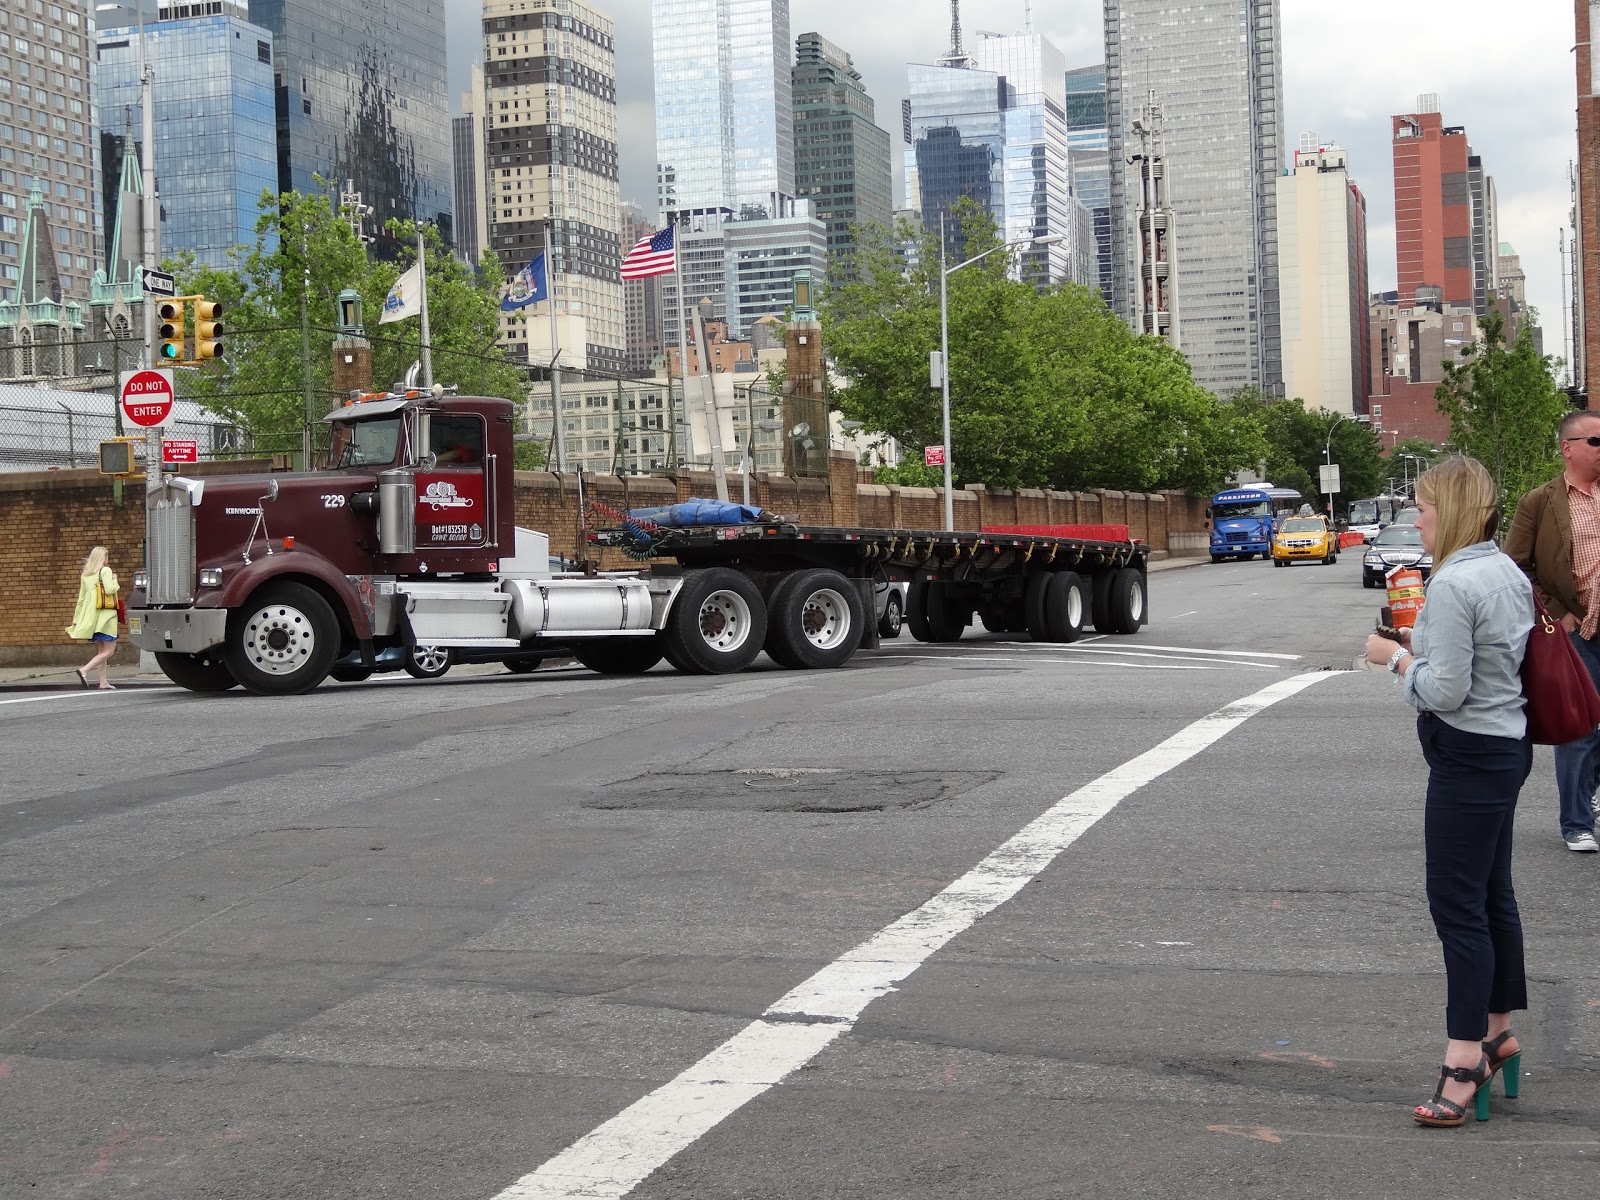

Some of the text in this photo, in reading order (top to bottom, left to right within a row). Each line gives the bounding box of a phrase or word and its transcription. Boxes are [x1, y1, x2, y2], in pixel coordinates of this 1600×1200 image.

[151, 276, 171, 290] ONE WAY
[130, 380, 164, 392] DO NOT
[133, 406, 162, 417] ENTER
